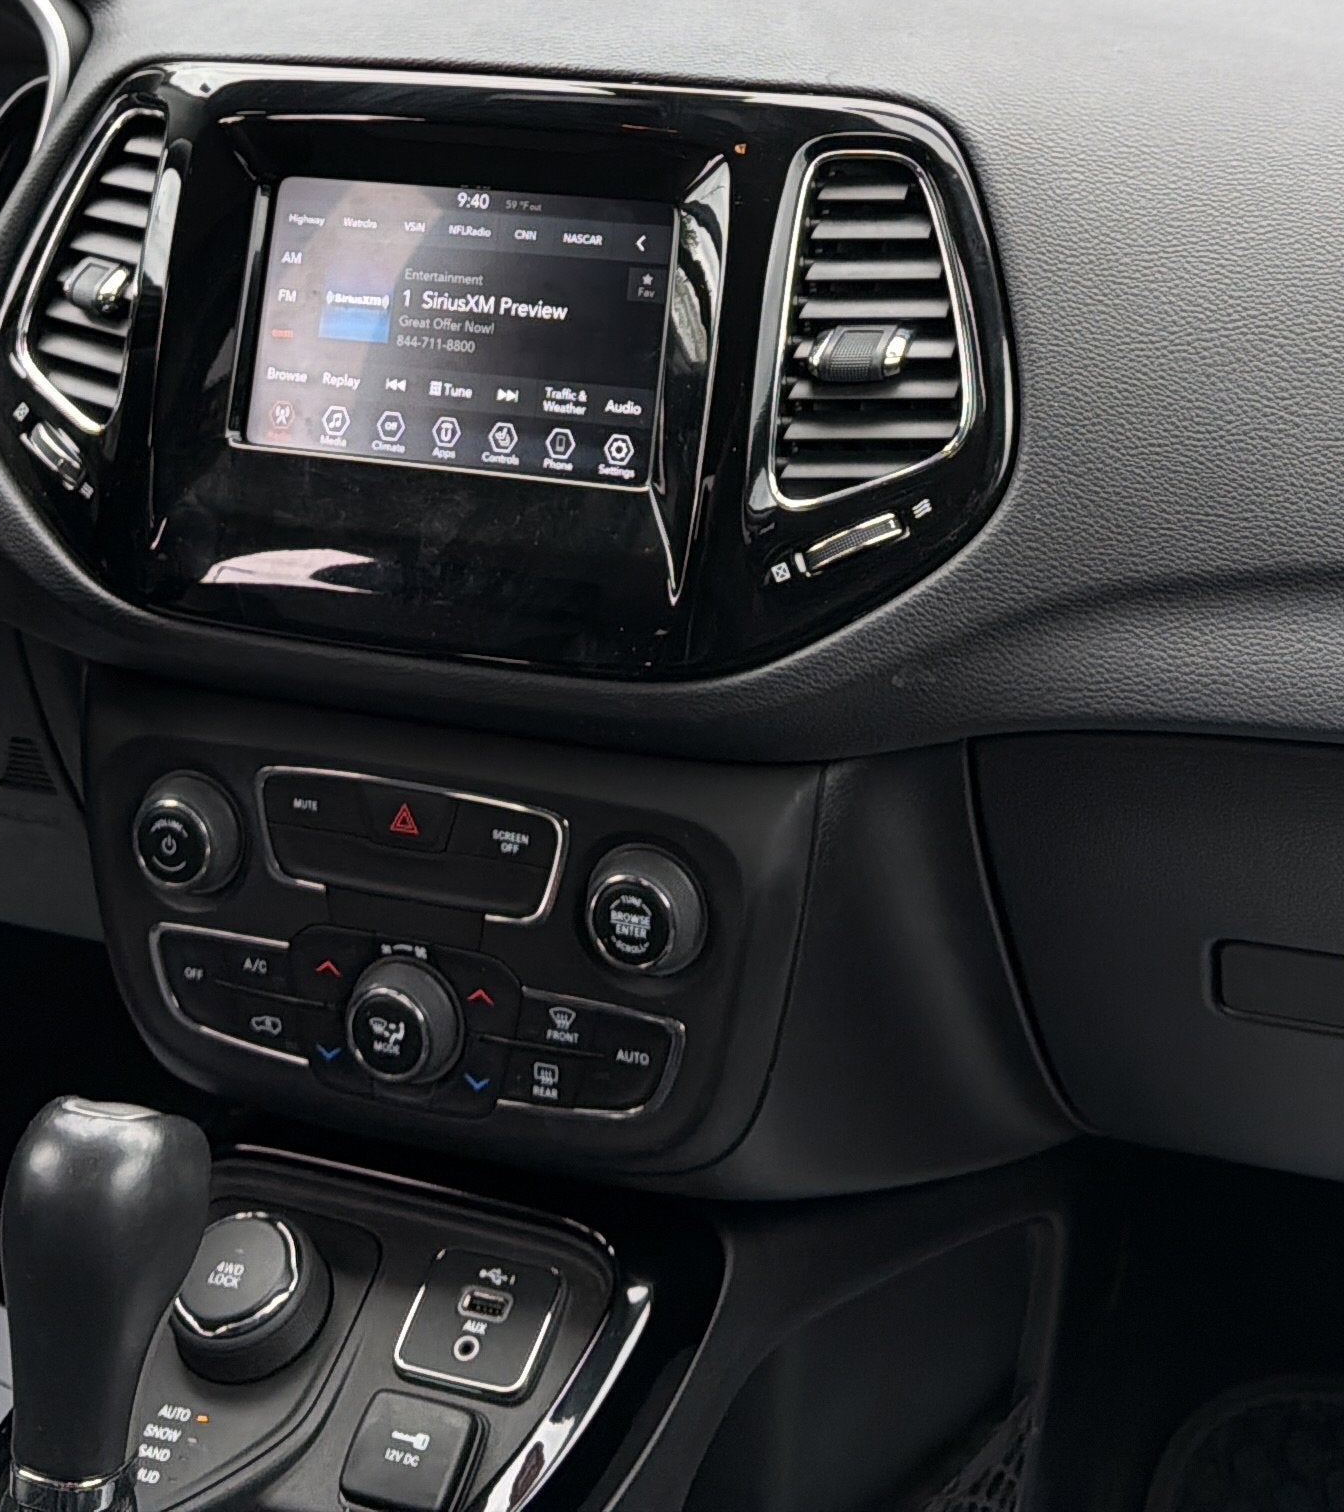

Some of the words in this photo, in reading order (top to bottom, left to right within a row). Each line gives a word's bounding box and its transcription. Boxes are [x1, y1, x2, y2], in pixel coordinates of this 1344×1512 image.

[457, 192, 490, 209] 9:40
[506, 199, 518, 210] 59
[530, 204, 542, 212] out
[288, 213, 326, 227] Highway
[448, 224, 492, 238] NFLRadio
[514, 229, 537, 241] CNN
[562, 232, 603, 246] NASCAR
[281, 251, 302, 264] AM
[405, 268, 484, 286] Entertainment
[278, 289, 297, 303] FM
[637, 286, 655, 298] Fav
[403, 289, 411, 307] 1
[421, 290, 495, 315] SiriusXM
[499, 296, 568, 320] Preview
[398, 315, 430, 329] Great
[433, 317, 462, 332] Offer
[464, 320, 495, 335] Now!
[396, 335, 476, 353] 844-711-8800
[267, 366, 308, 383] Browse
[322, 371, 361, 391] Replay
[444, 383, 473, 399] Tune
[545, 386, 577, 402] Traffic
[577, 389, 588, 402] &
[543, 400, 586, 416] Weather
[604, 399, 642, 416] Audio
[320, 435, 347, 448] Media
[371, 440, 406, 454] Climate
[432, 446, 456, 459] Apps
[481, 451, 520, 466] Controls
[543, 457, 573, 471] Phone
[598, 463, 635, 479] Settings
[293, 797, 318, 812] MUTE
[492, 829, 529, 845] SCREEN
[500, 842, 520, 855] OFF
[620, 895, 642, 907] TUNE
[610, 909, 651, 926] BROWSE
[615, 923, 647, 939] ENTER
[183, 966, 204, 980] OFF
[243, 957, 268, 974] A/C
[546, 1028, 579, 1044] FRONT
[373, 1040, 400, 1056] MODE
[616, 1048, 650, 1066] AUTO
[532, 1084, 558, 1100] REAR
[216, 1260, 245, 1276] 4WD
[207, 1271, 241, 1289] LOCK
[462, 1319, 488, 1335] AUX
[158, 1404, 192, 1422] AUTO
[143, 1423, 182, 1443] SNOW
[138, 1443, 171, 1462] SAND
[385, 1446, 404, 1464] 12V
[402, 1452, 420, 1468] DC
